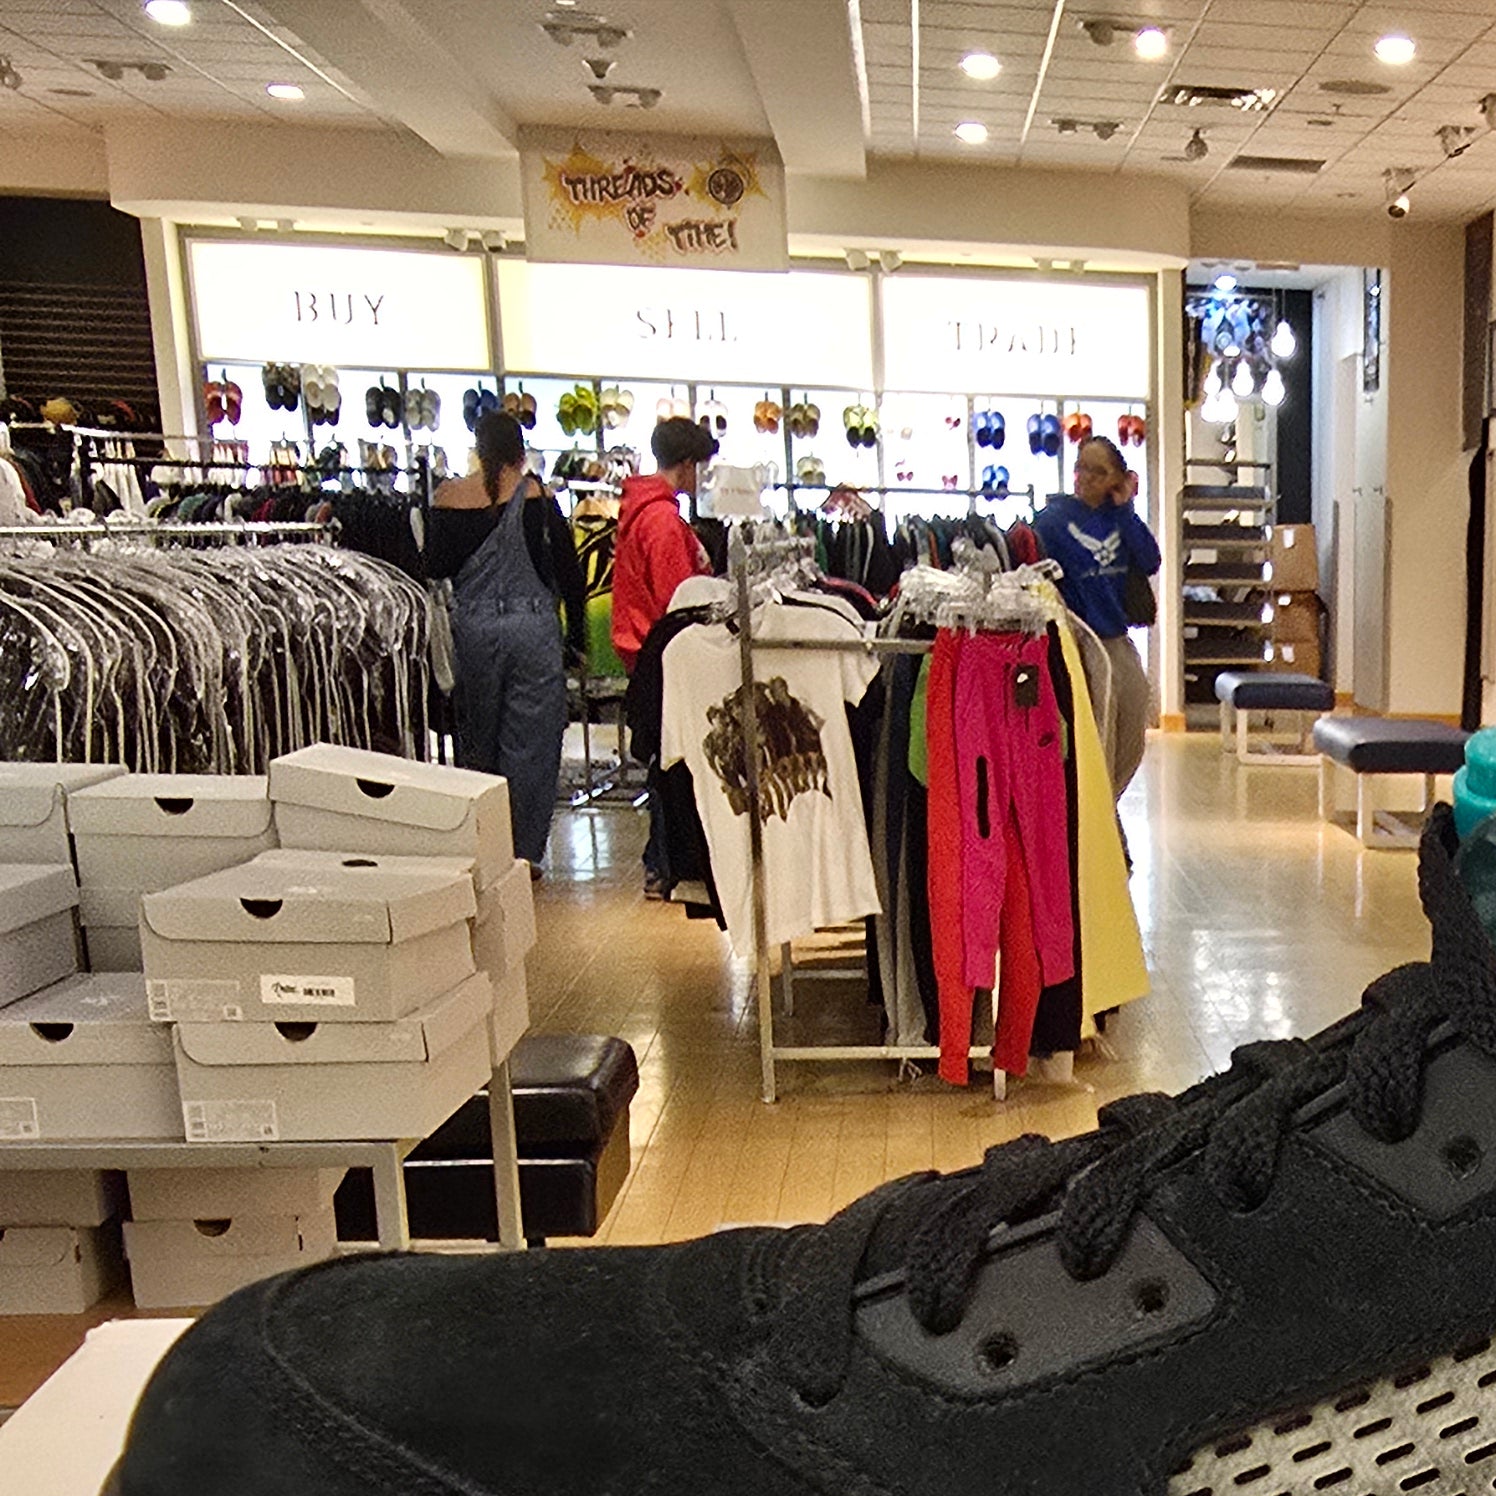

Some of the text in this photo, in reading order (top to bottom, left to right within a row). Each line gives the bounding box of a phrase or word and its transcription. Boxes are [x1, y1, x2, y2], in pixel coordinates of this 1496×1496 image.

[564, 169, 674, 202] THREADS
[626, 203, 656, 231] OF
[294, 290, 384, 325] BUY
